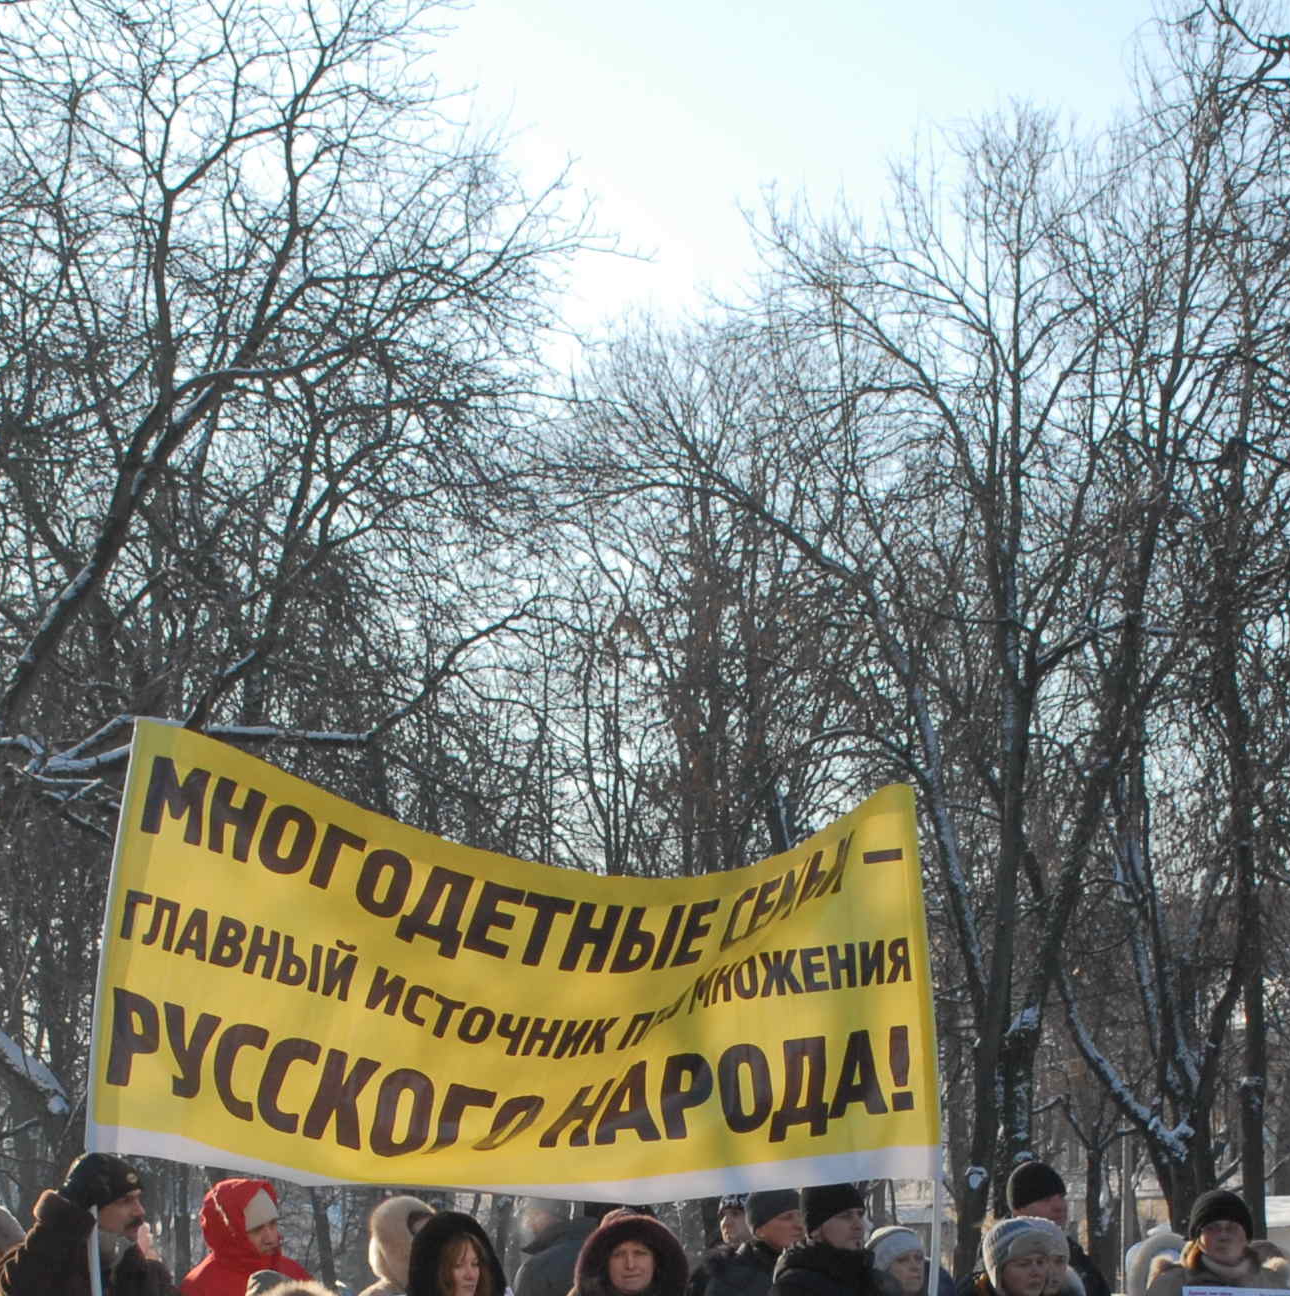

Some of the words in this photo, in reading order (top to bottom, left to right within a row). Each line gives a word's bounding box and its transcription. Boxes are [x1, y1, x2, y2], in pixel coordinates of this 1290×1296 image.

[141, 756, 720, 973] МНОГОДЕТНЫЕ
[120, 889, 357, 1001] ГЛАВНЫЙ
[365, 966, 620, 1059] ИСТОЧНИК
[616, 937, 912, 1051] ПМНОЖЕНИЯ
[106, 987, 545, 1157] РУССКОГО
[539, 1025, 914, 1148] НАРОДА!
